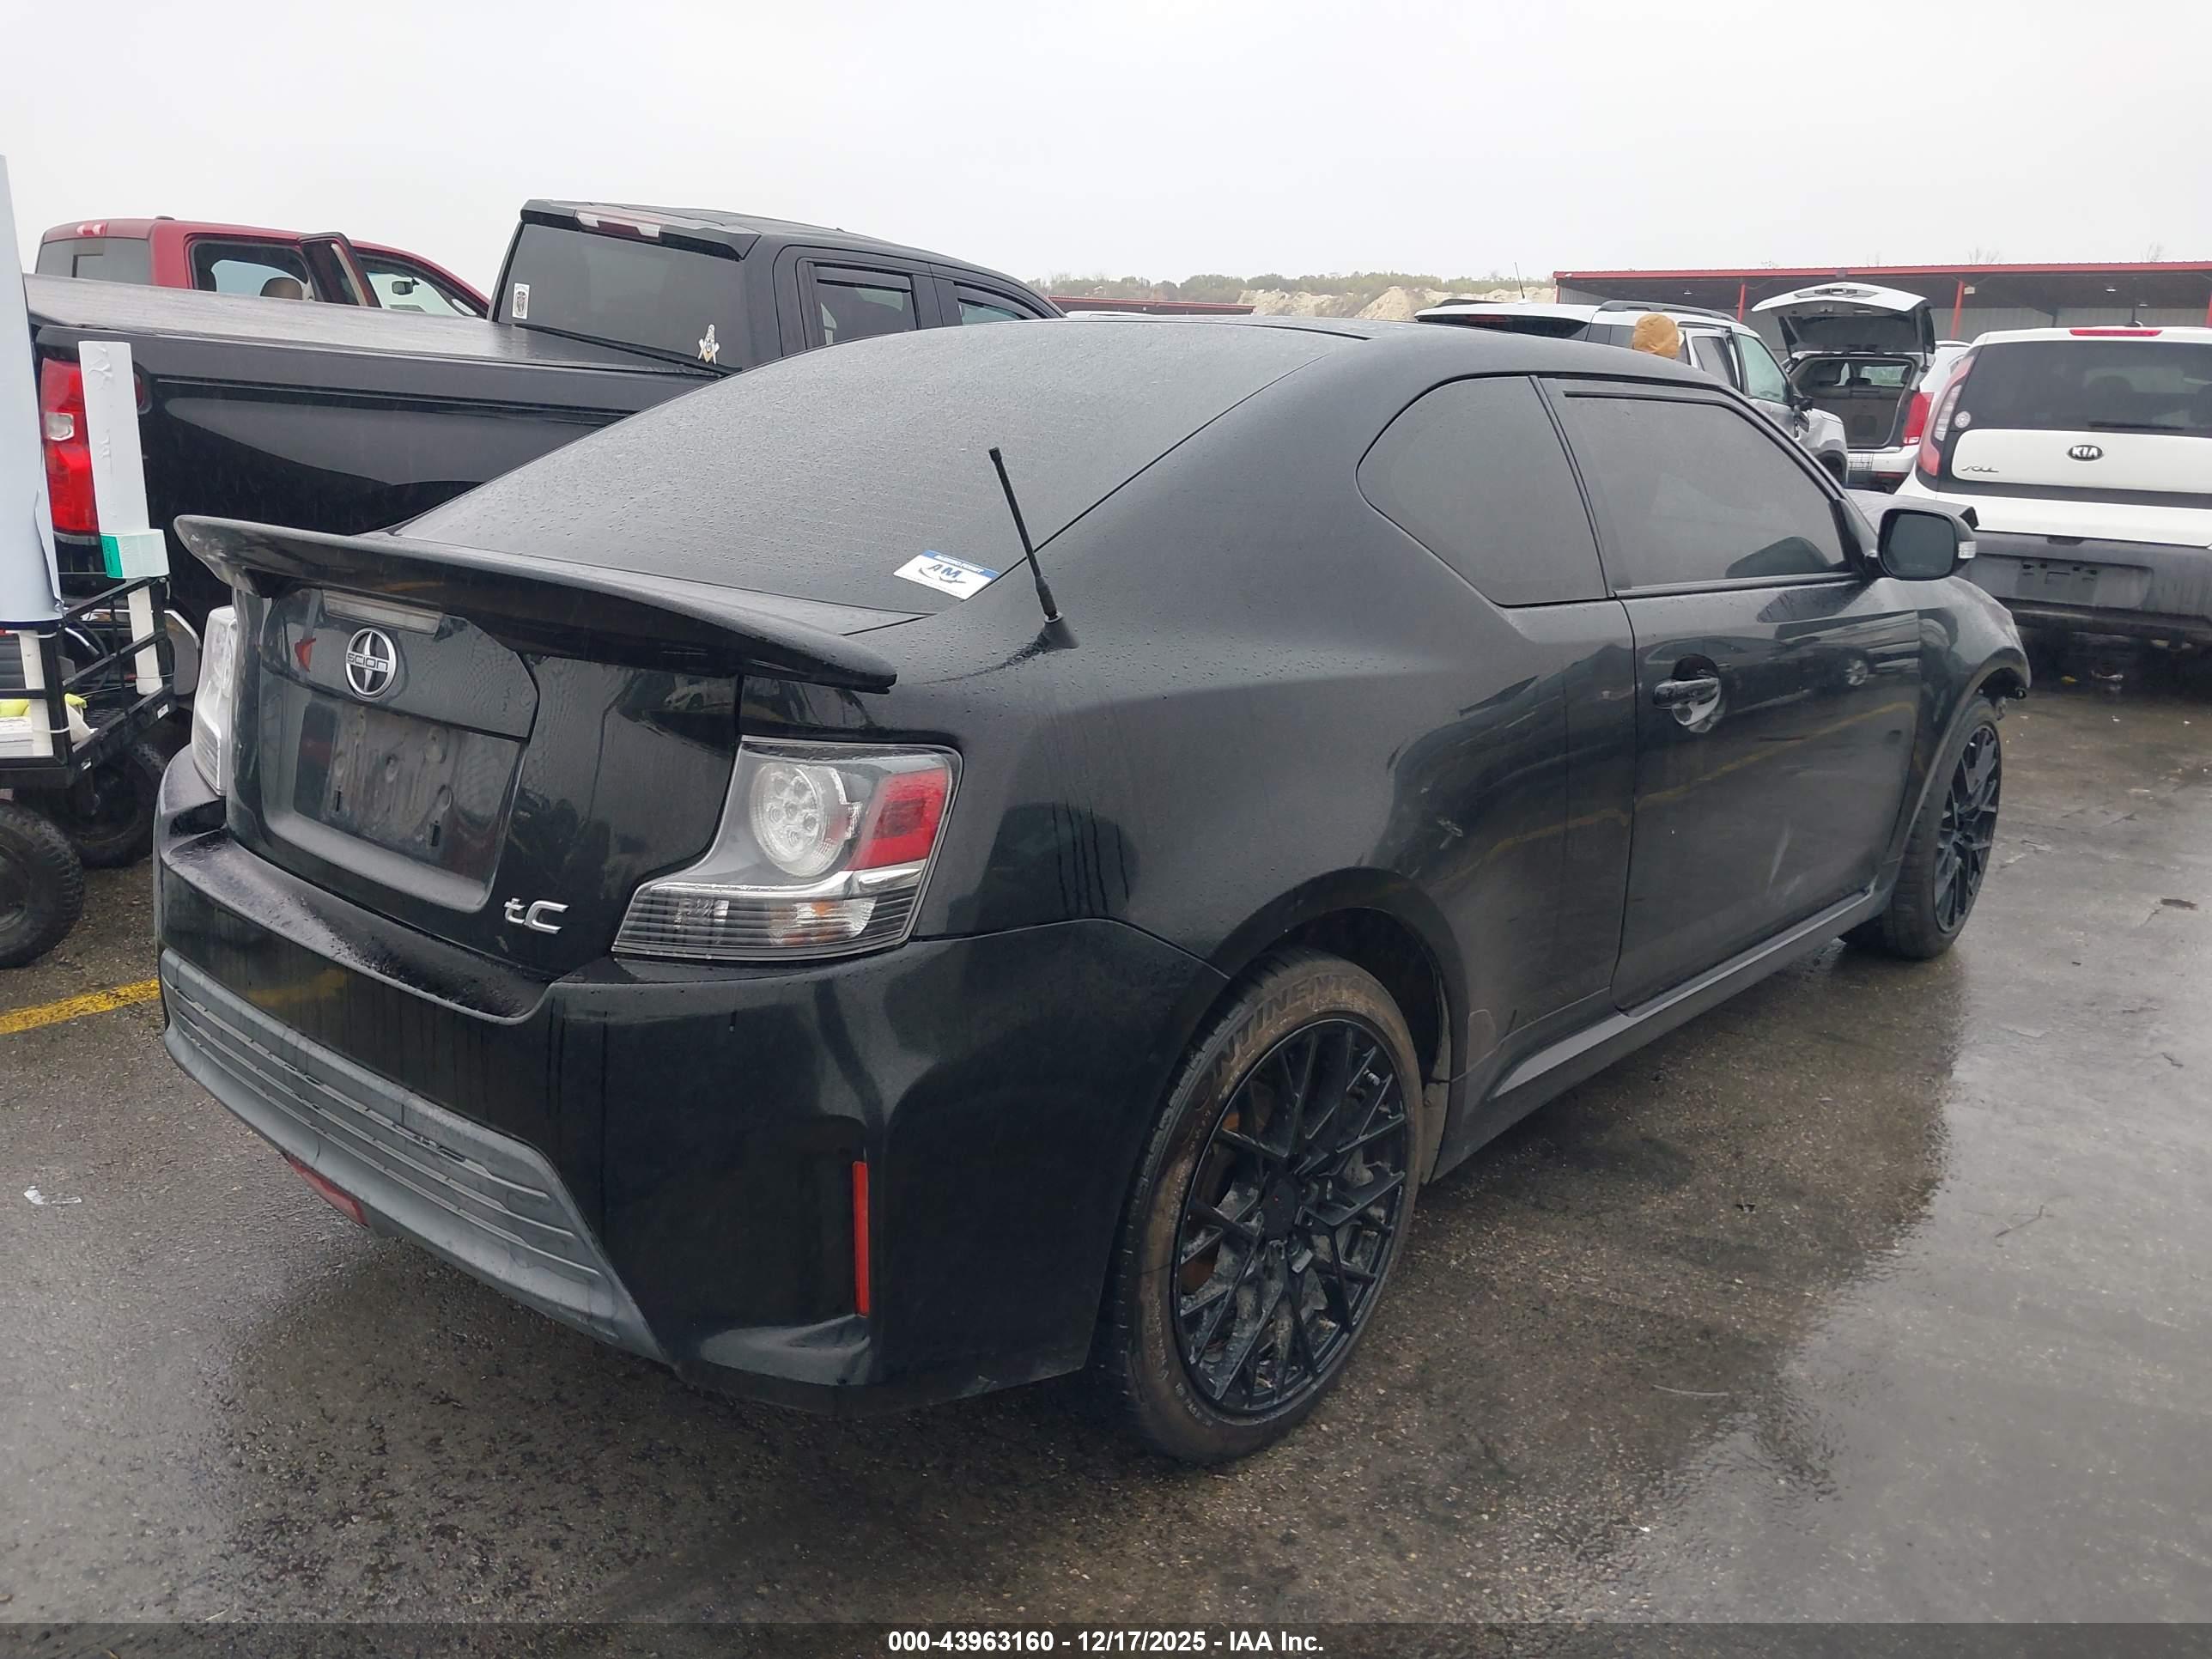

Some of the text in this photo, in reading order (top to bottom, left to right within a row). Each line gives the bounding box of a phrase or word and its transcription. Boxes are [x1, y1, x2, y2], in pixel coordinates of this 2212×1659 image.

[2072, 446, 2099, 458] KIA
[347, 652, 389, 672] SCION
[503, 897, 569, 935] tC
